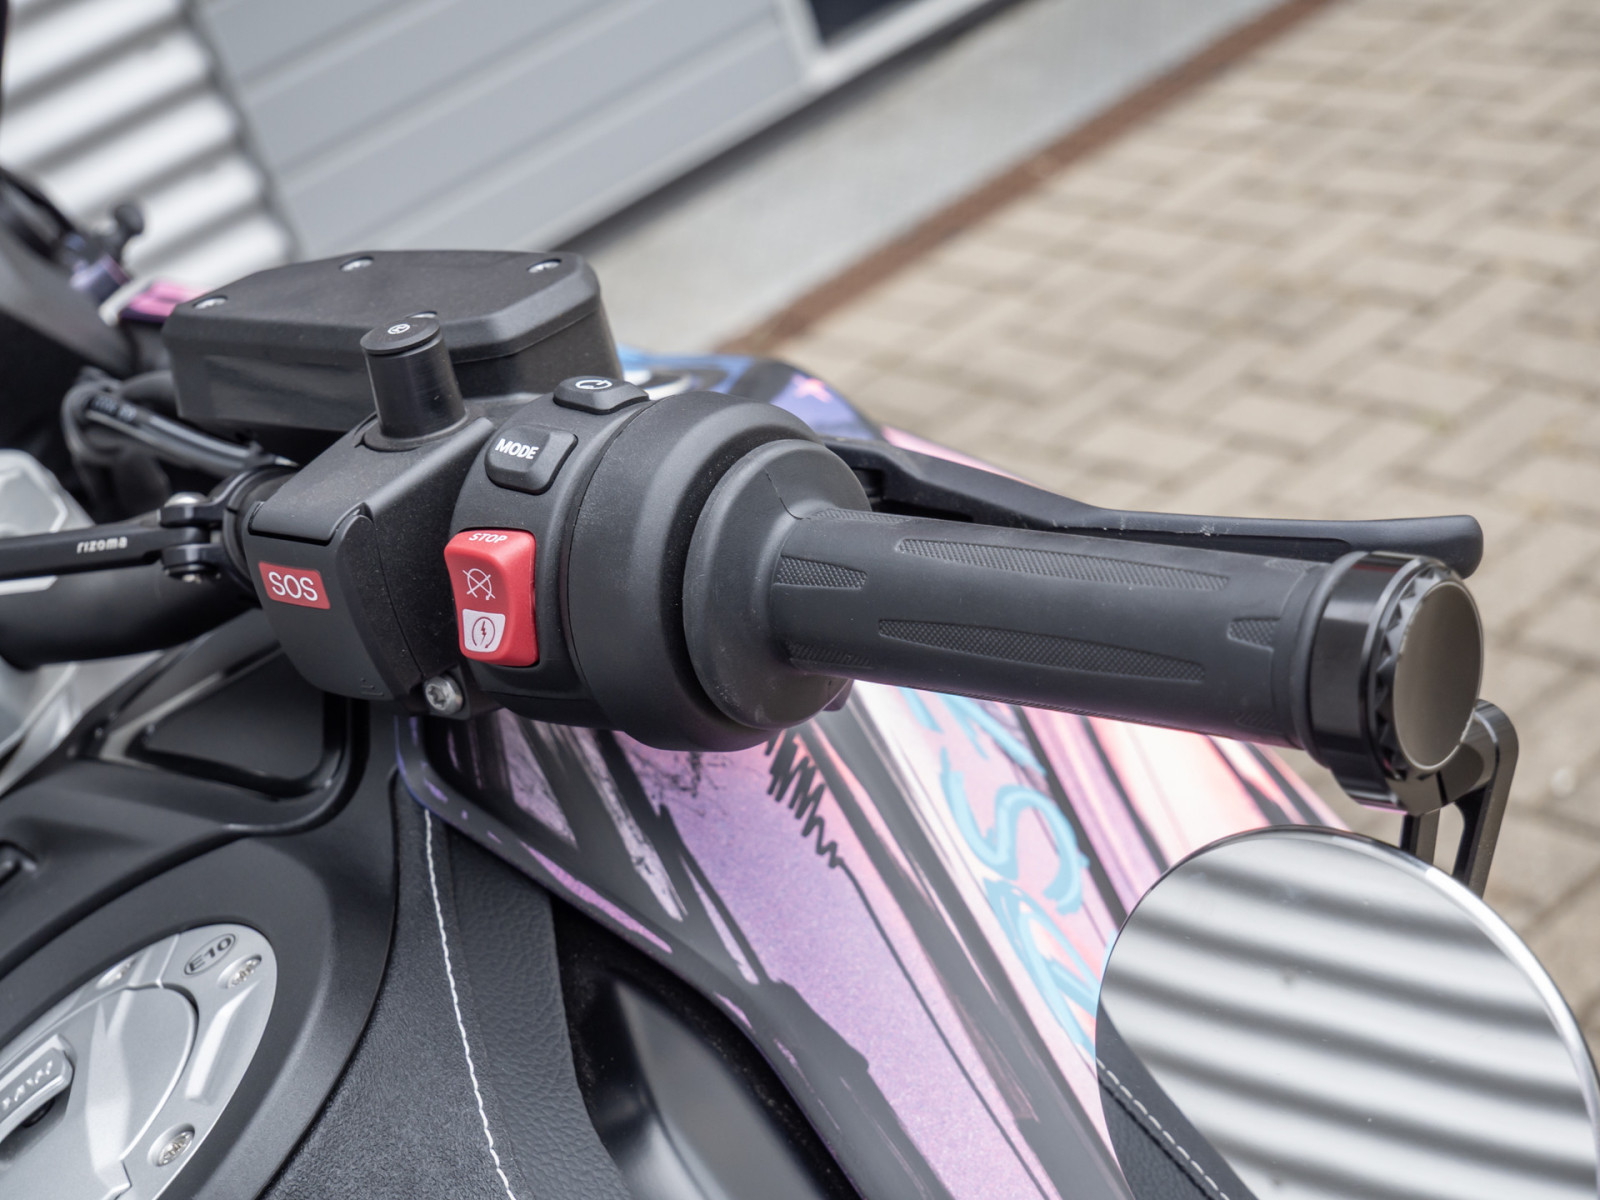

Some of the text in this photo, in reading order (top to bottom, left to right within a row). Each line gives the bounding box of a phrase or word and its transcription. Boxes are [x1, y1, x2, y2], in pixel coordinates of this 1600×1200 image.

[495, 438, 540, 460] MODE
[76, 536, 128, 554] rizoma
[468, 532, 509, 544] STOP
[268, 571, 318, 602] SOS
[189, 937, 232, 972] E10
